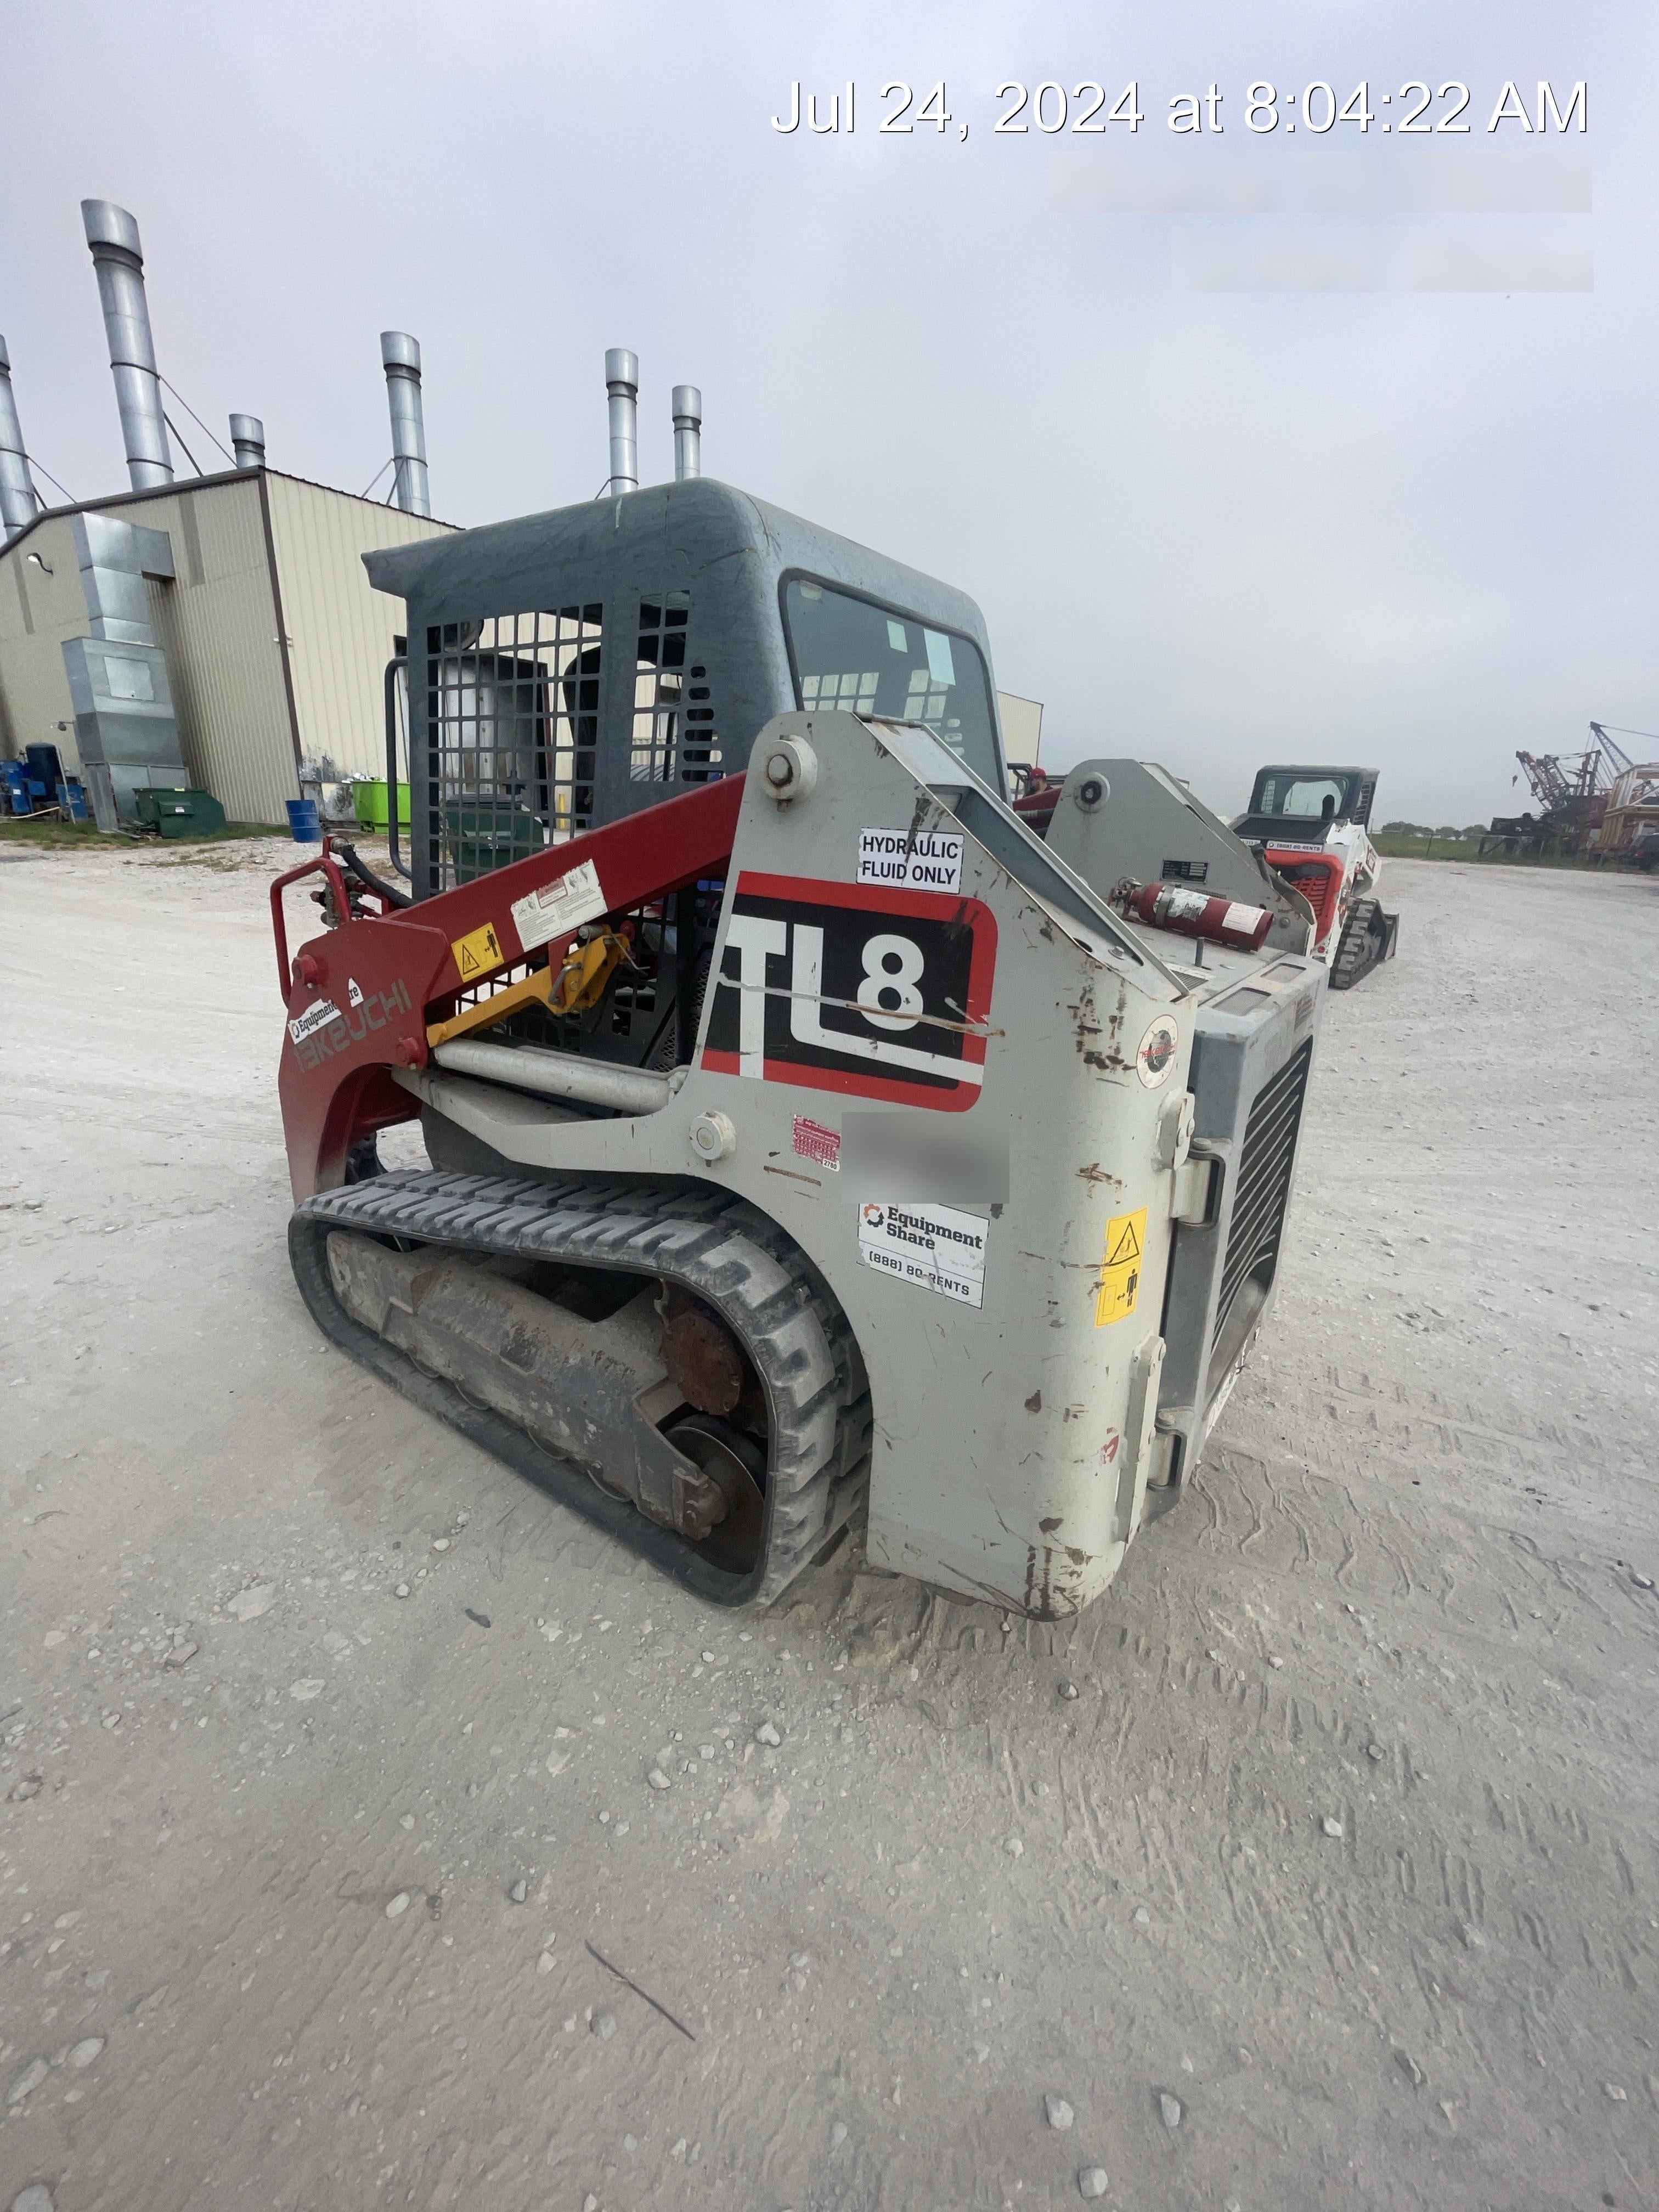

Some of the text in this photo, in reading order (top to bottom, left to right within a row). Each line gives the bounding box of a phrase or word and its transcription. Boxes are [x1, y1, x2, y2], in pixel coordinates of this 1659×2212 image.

[862, 836, 958, 859] HYDRAULIC
[862, 860, 956, 885] FLUID ONLY
[823, 1159, 837, 1170] 2780
[886, 1222, 935, 1250] Share
[887, 1206, 983, 1250] Equipment
[869, 1251, 969, 1295] (888) 80-RENTS
